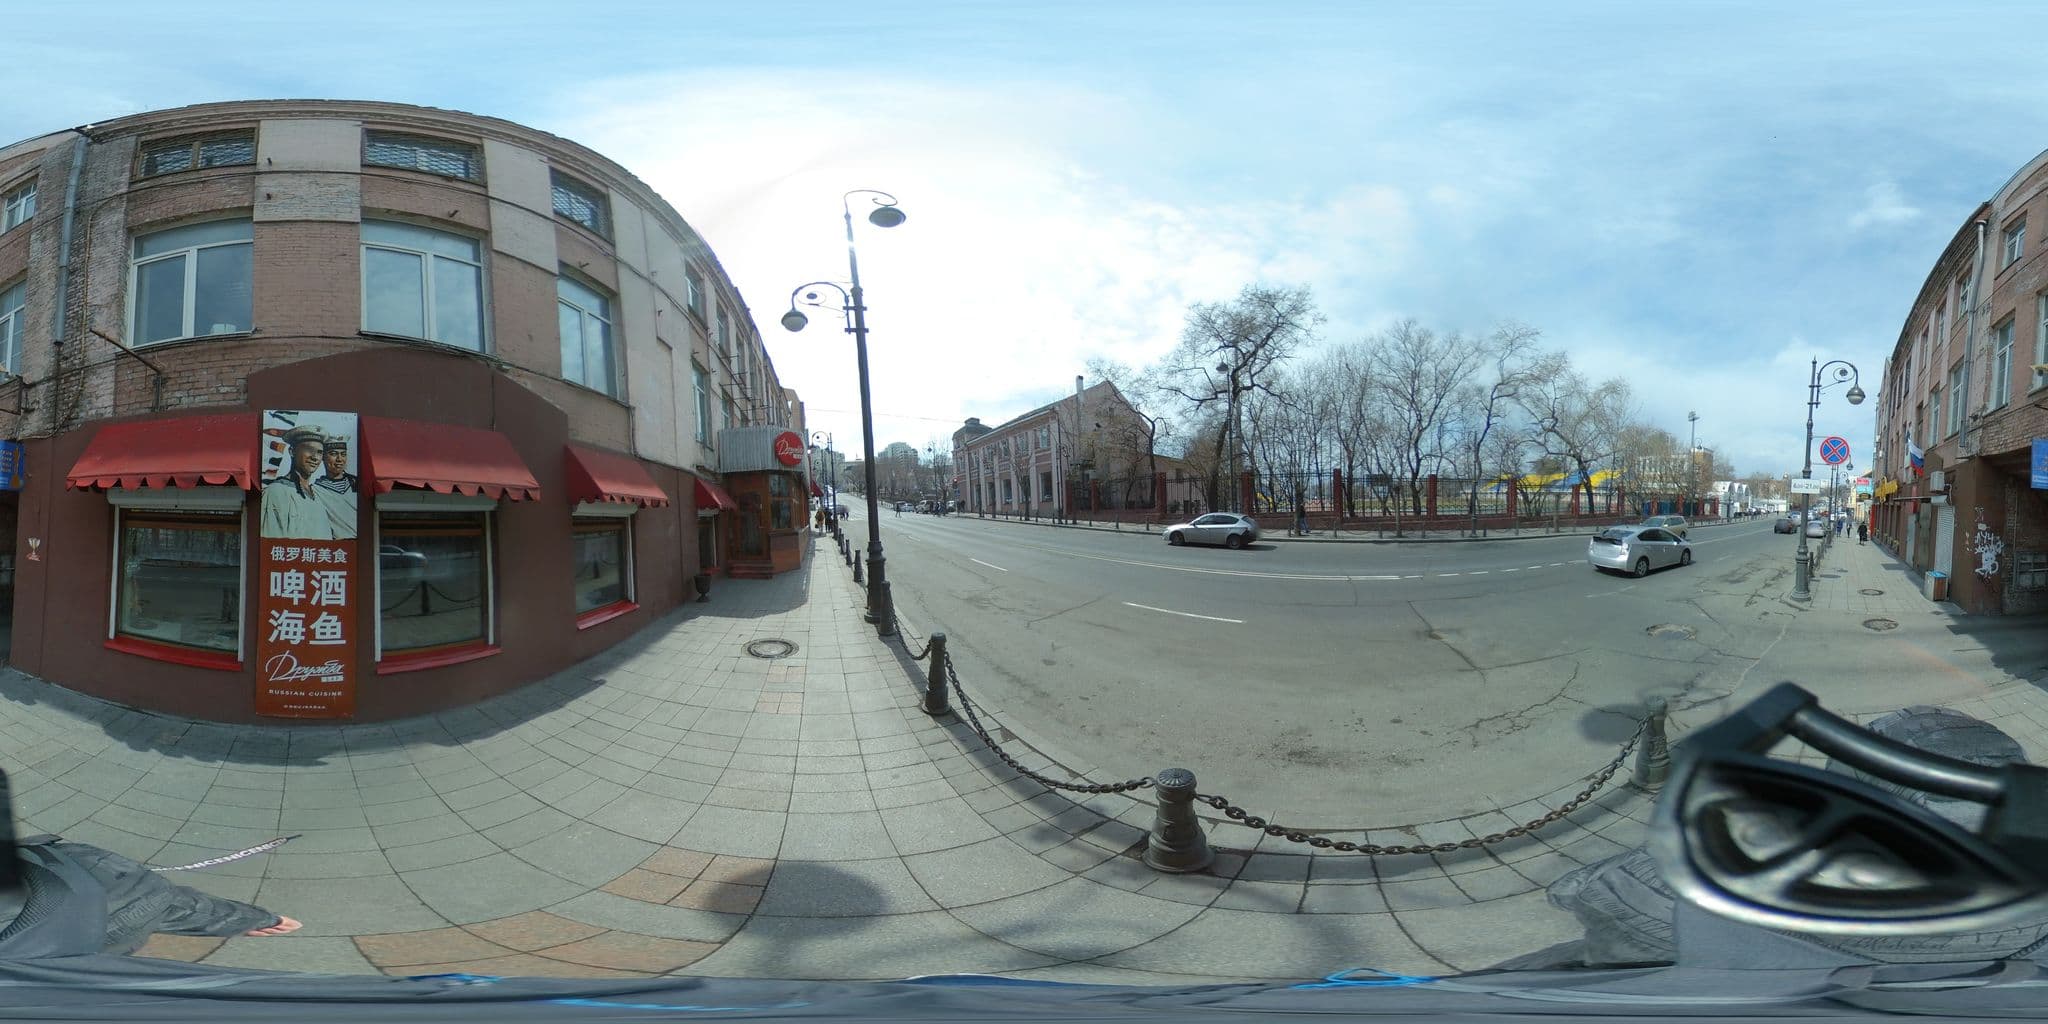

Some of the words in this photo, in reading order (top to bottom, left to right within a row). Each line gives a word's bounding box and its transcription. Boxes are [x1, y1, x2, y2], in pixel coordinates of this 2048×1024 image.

[270, 546, 347, 563] 俄罗斯美食
[270, 569, 347, 606] 啤酒
[268, 609, 346, 645] 海鱼
